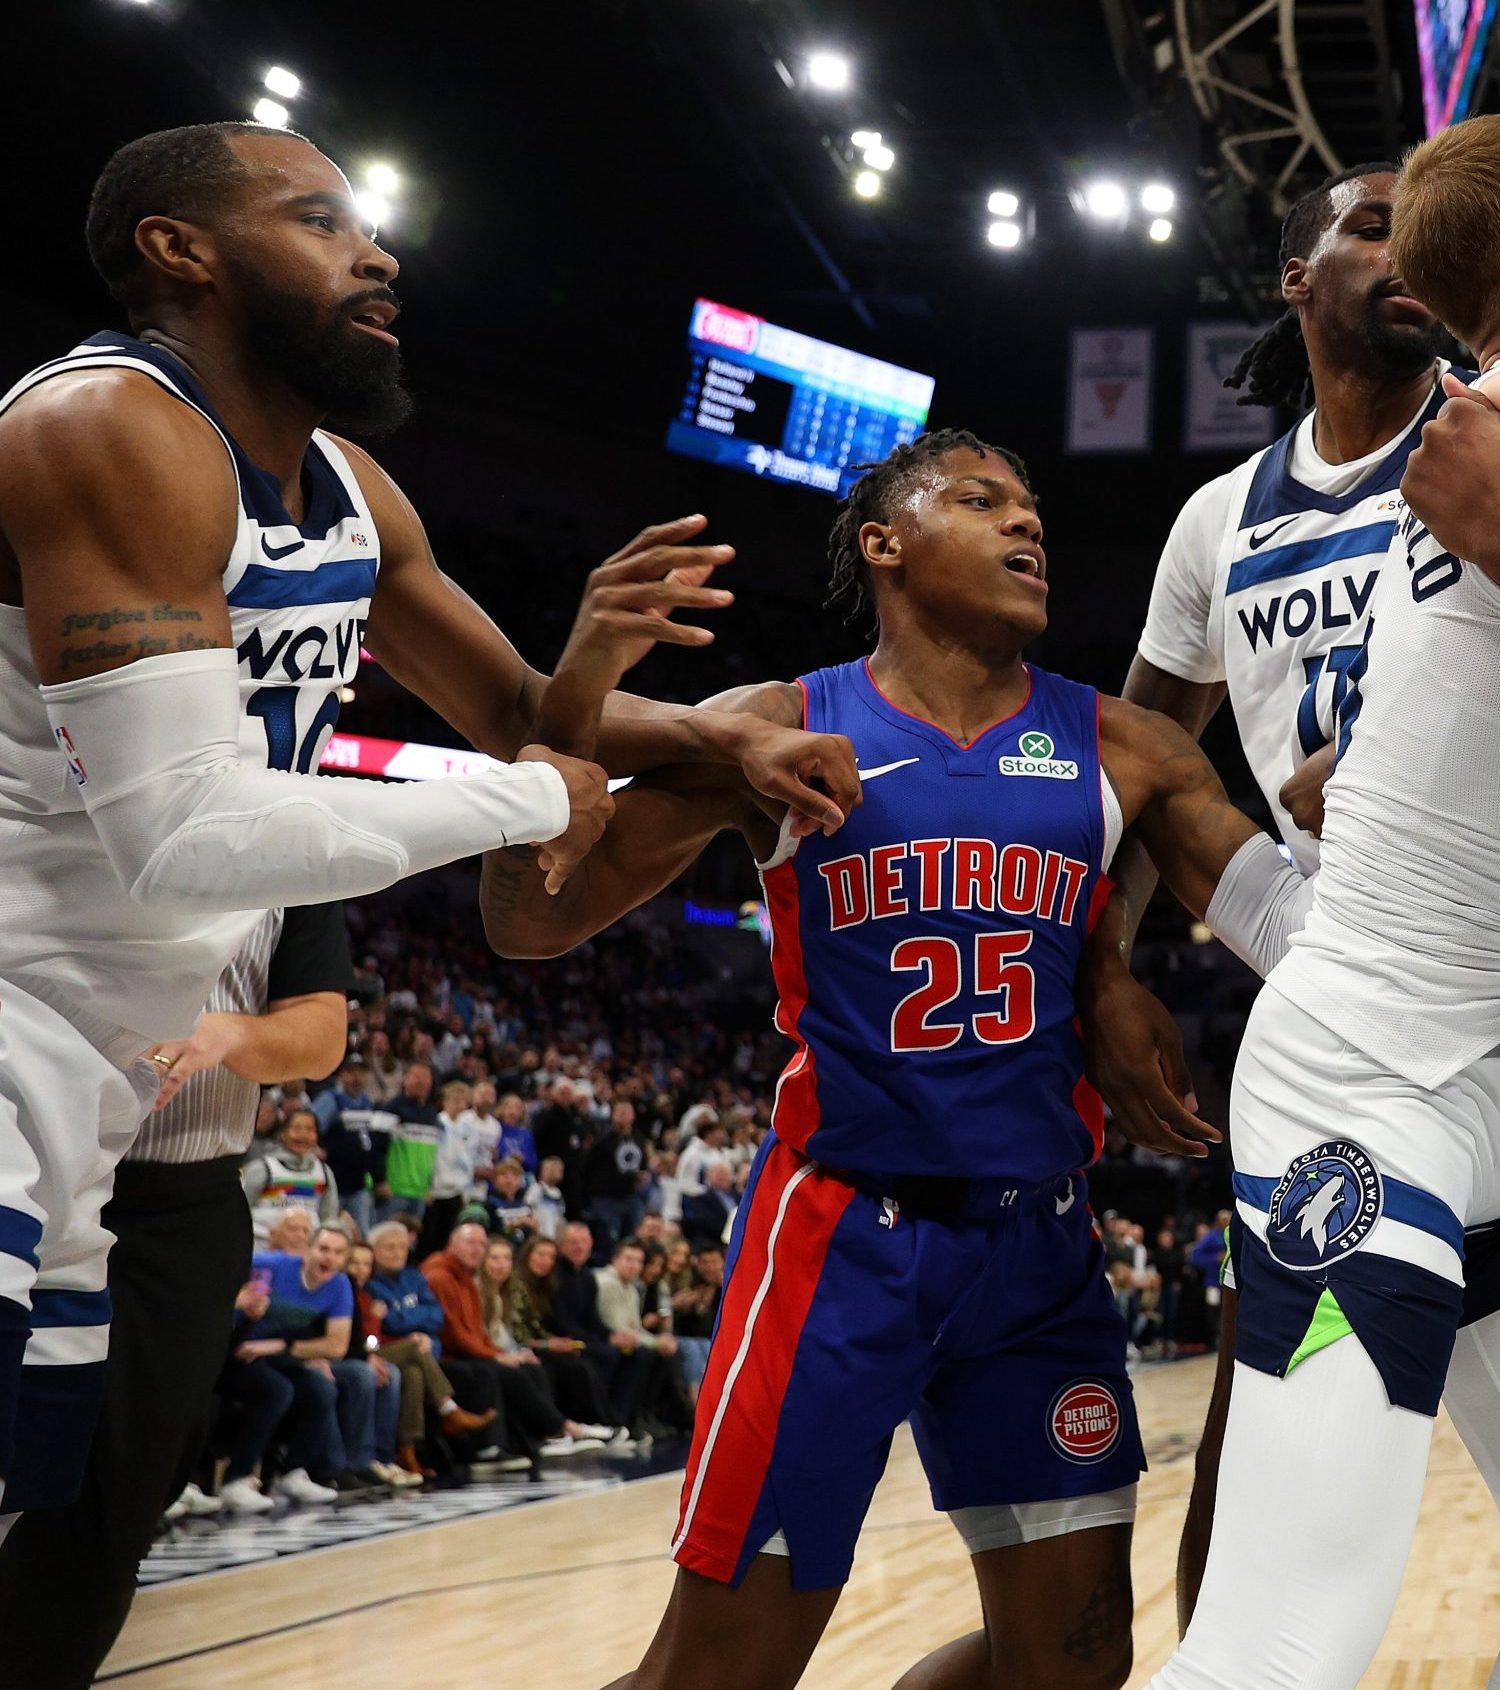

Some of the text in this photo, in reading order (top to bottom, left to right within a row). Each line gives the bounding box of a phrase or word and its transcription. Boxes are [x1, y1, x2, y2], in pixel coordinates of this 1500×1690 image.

[152, 603, 202, 621] them
[1001, 758, 1075, 777] StockX
[817, 837, 1088, 931] DETROIT
[890, 929, 1036, 1053] 25
[1270, 1144, 1378, 1250] MINNESOTA TIMBERWOLVES
[1063, 1403, 1109, 1423] DETROIT
[1063, 1416, 1112, 1437] PISTONS
